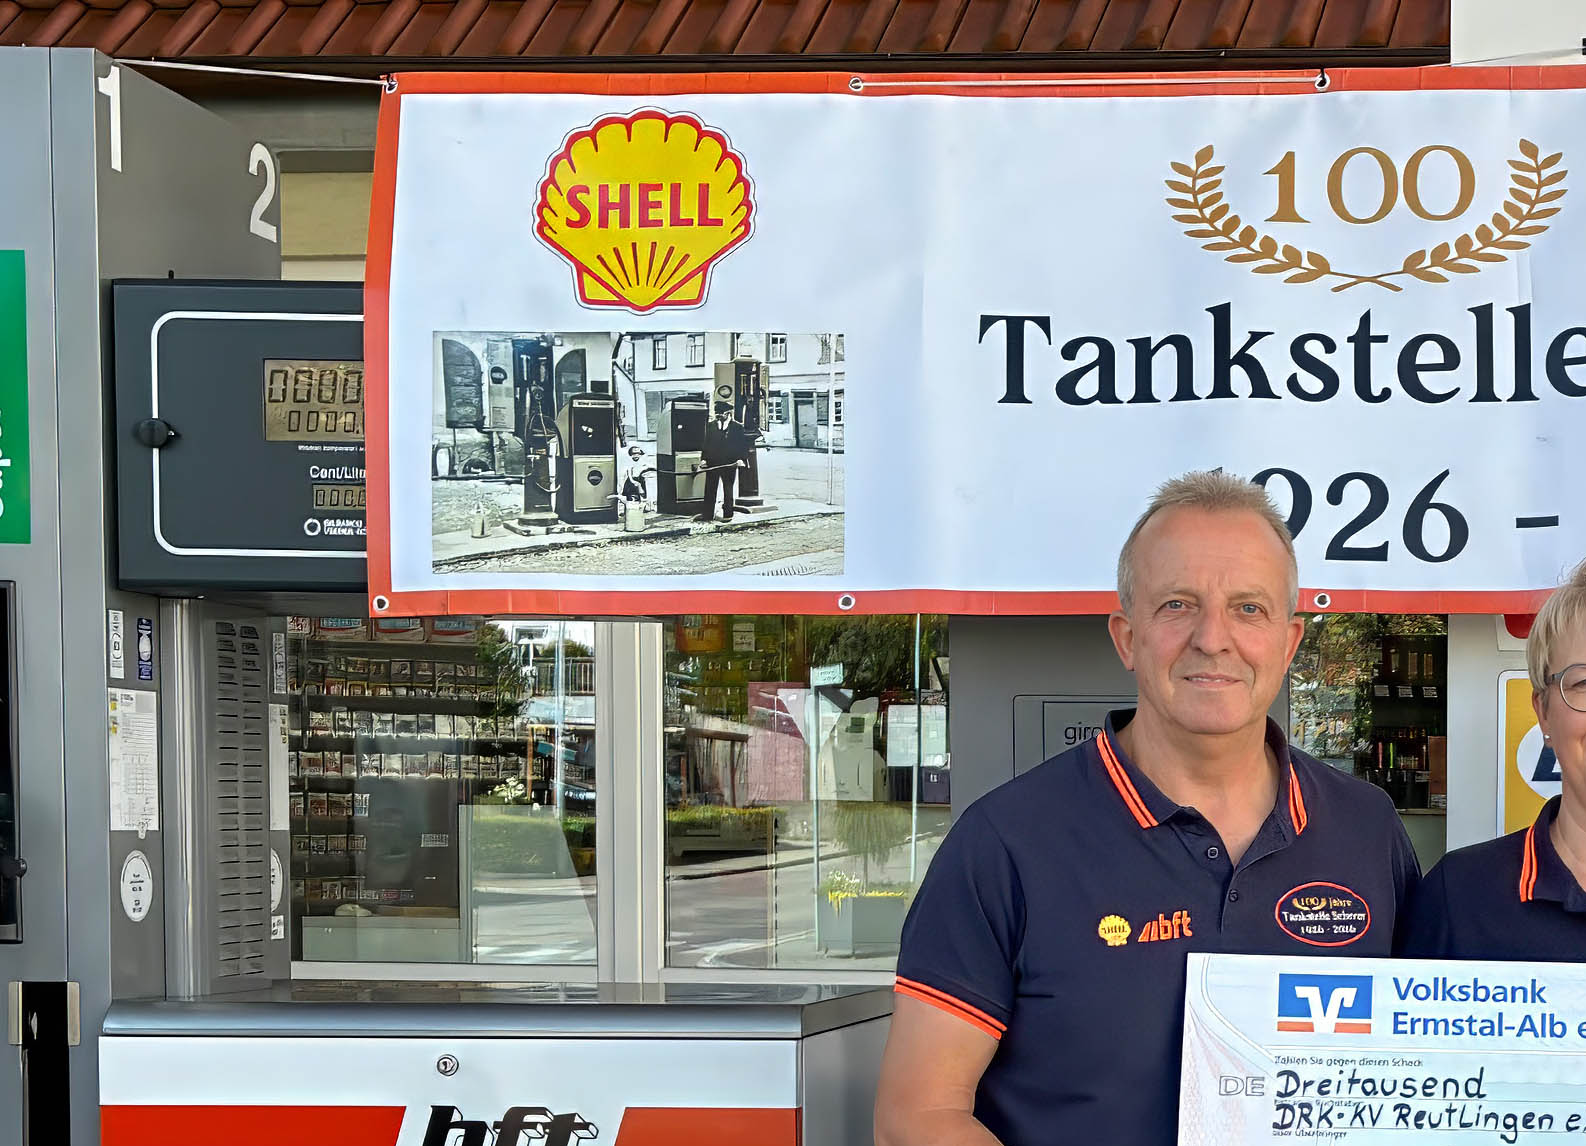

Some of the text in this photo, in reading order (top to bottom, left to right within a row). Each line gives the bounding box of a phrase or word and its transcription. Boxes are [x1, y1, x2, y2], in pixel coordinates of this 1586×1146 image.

[99, 65, 122, 172] 1
[248, 142, 277, 243] 2
[1263, 144, 1475, 224] 100
[565, 182, 724, 230] SHELL
[1207, 466, 1470, 563] 926
[1159, 910, 1193, 940] bft
[1392, 976, 1547, 1004] Volksbank
[1392, 1012, 1567, 1038] Ermstal-Alb
[1218, 1075, 1265, 1097] DE
[1276, 1067, 1487, 1098] Dreitausend
[1393, 1102, 1554, 1144] Reutlingen
